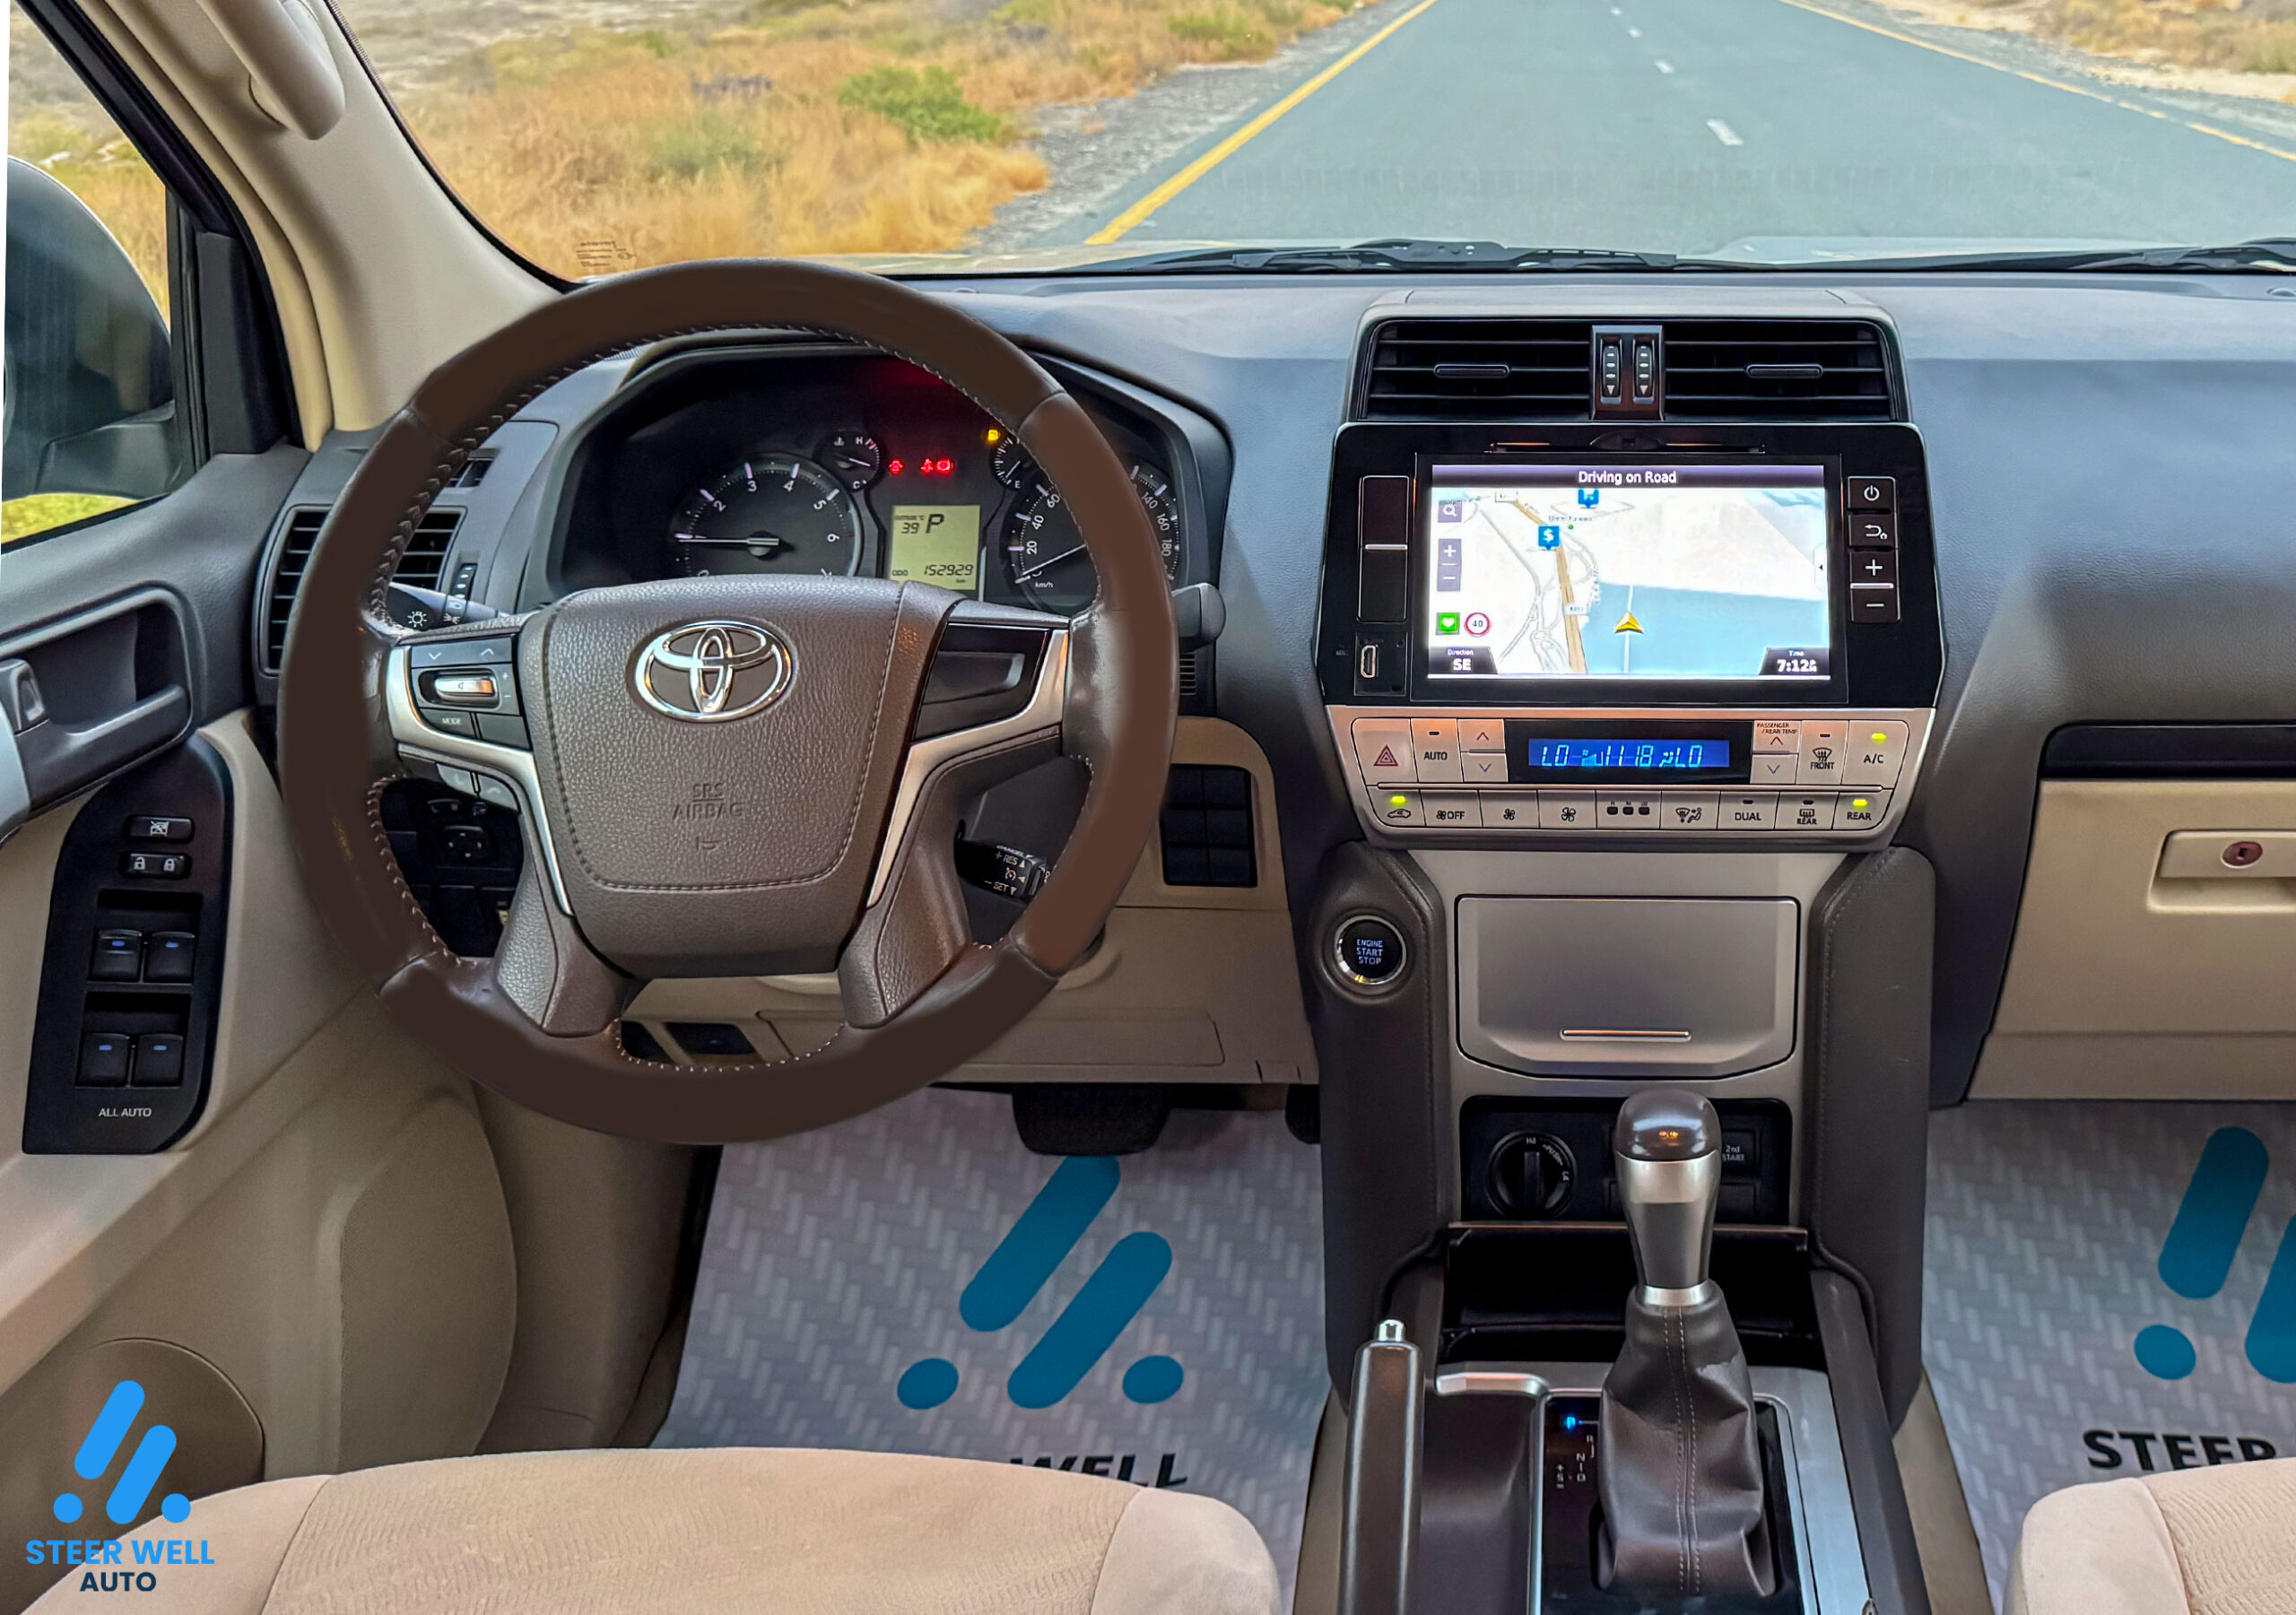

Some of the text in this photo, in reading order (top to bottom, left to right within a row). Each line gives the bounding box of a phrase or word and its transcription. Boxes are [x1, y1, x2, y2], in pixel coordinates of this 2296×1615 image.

[1578, 471, 1676, 486] Driving on Road
[747, 480, 758, 492] 3
[783, 480, 795, 492] 4
[713, 500, 727, 512] 2
[813, 499, 827, 511] 5
[1047, 493, 1060, 508] 60
[1141, 492, 1159, 509] 140
[900, 522, 920, 534] 39
[926, 514, 944, 534] P
[1031, 515, 1045, 530] 40
[1156, 513, 1170, 532] 160
[827, 533, 840, 543] 6
[1026, 540, 1038, 555] 20
[1161, 538, 1172, 557] 180
[924, 564, 974, 576] 152929
[1447, 648, 1474, 656] Direction
[1453, 658, 1472, 671] SE
[442, 717, 462, 725] MODE
[1423, 751, 1448, 760] AUTO
[1864, 754, 1883, 764] A/C
[1810, 761, 1835, 769] FRONT
[1447, 811, 1465, 820] OFF
[1735, 812, 1761, 821] DUAL
[1847, 812, 1872, 821] REAR
[993, 881, 1010, 892] SET
[1356, 939, 1384, 948] ENGINE
[1356, 947, 1384, 957] START
[1358, 956, 1382, 965] STOP
[99, 1107, 152, 1117] ALL AUTO
